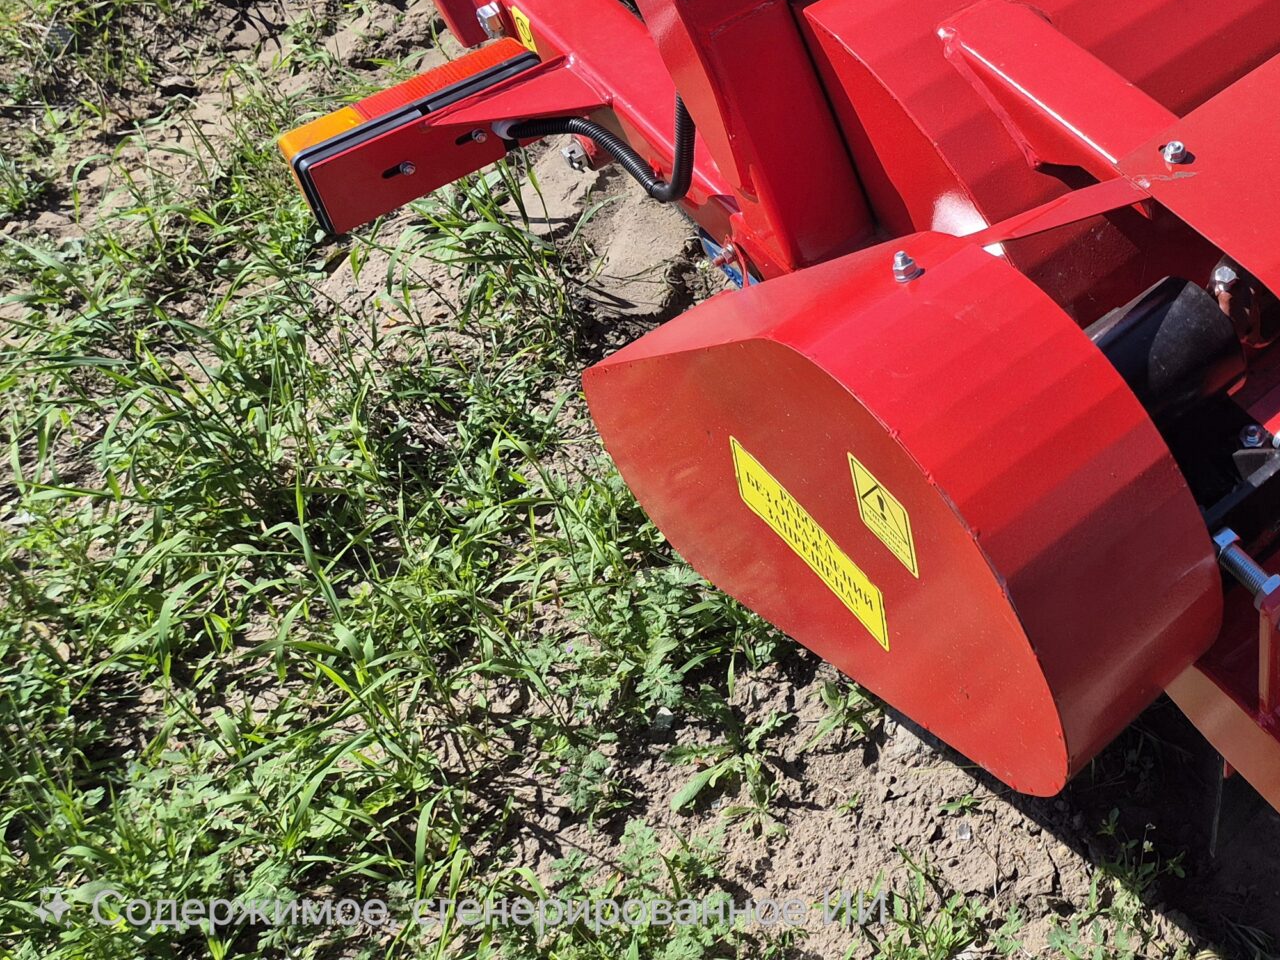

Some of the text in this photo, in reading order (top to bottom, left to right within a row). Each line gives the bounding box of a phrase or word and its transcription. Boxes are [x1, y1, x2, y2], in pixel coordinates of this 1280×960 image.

[745, 471, 874, 611] БЕЗ ОГРАЖДЕНИЙ
[766, 505, 859, 611] ЗАПРЕЩЕНА!
[779, 489, 834, 553] РАБОТА
